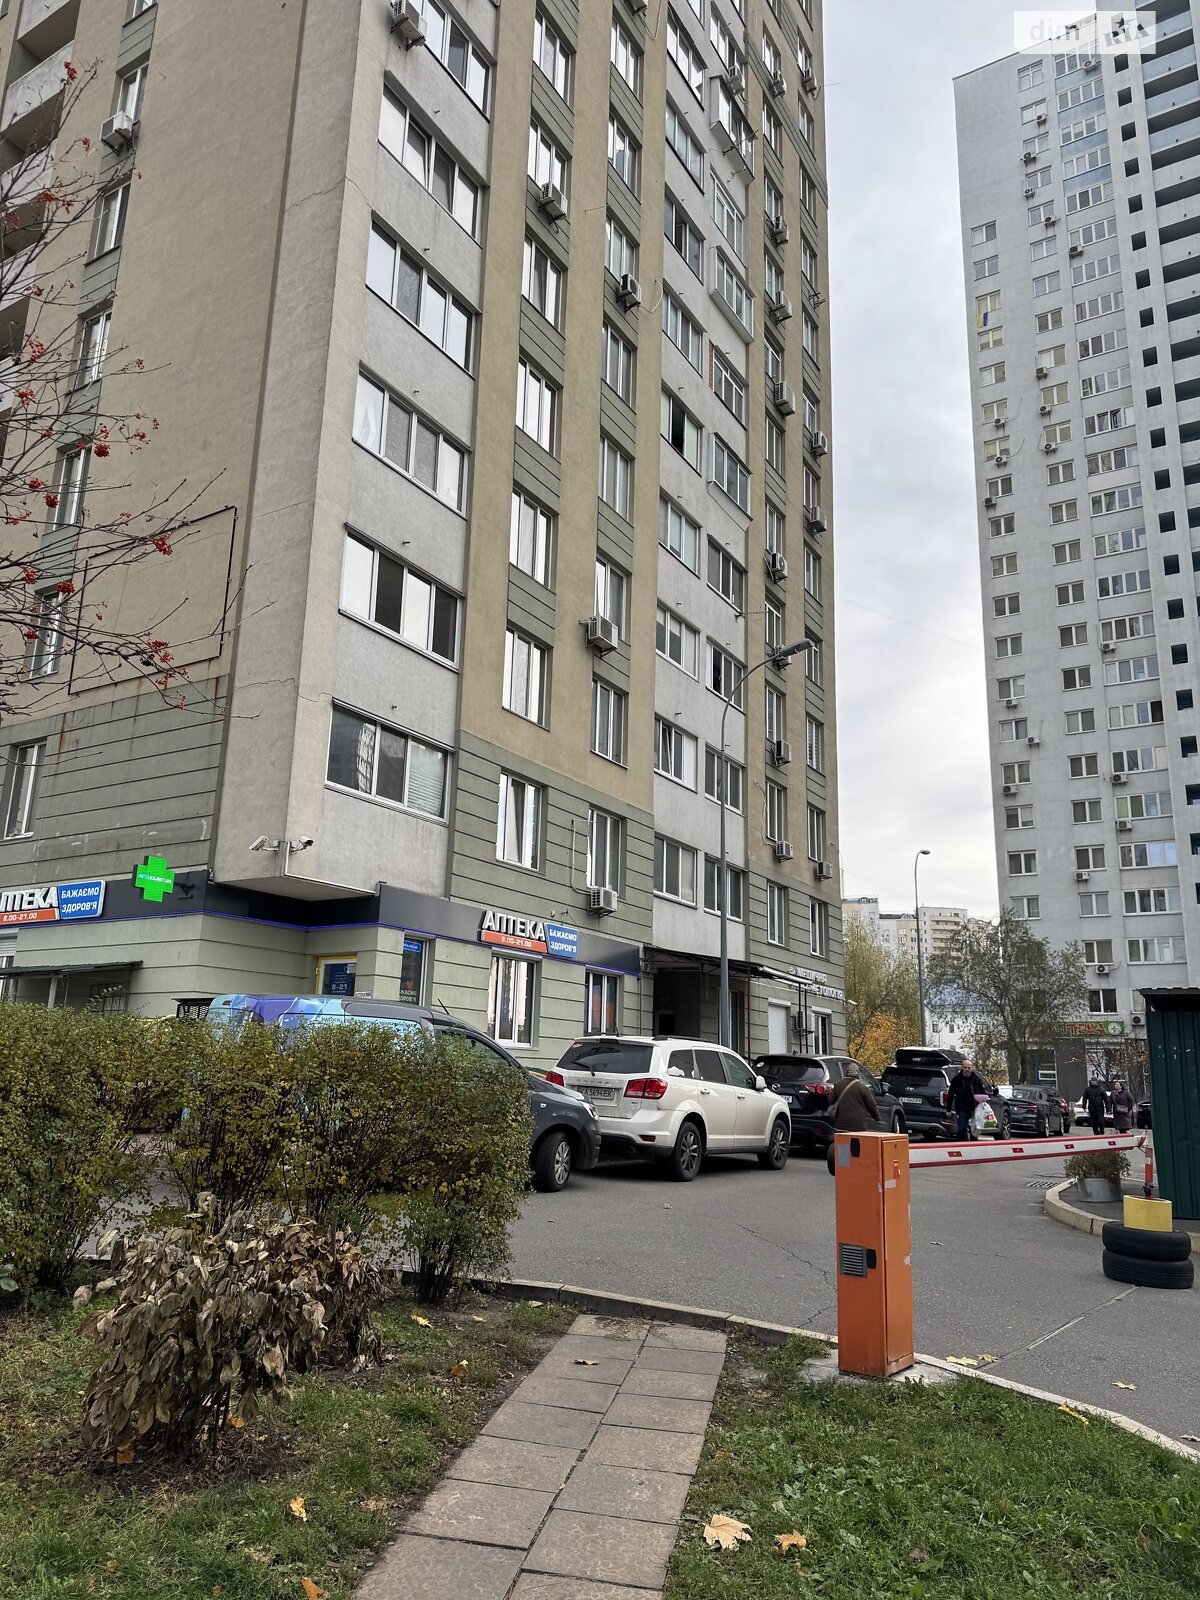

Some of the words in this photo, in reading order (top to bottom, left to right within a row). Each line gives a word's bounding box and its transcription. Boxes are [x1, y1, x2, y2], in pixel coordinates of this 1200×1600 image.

[0, 886, 59, 912] ПТЕКА
[61, 887, 100, 899] БАЖАЄМО
[61, 901, 98, 914] ЗДОРОВ'Я
[3, 912, 38, 922] 8.00-21.00
[482, 910, 546, 941] АПТЕКА
[549, 929, 577, 942] БАЖАЄМО
[501, 936, 532, 948] 8.00-21.00
[550, 941, 577, 953] ЗДОРОВ'Я
